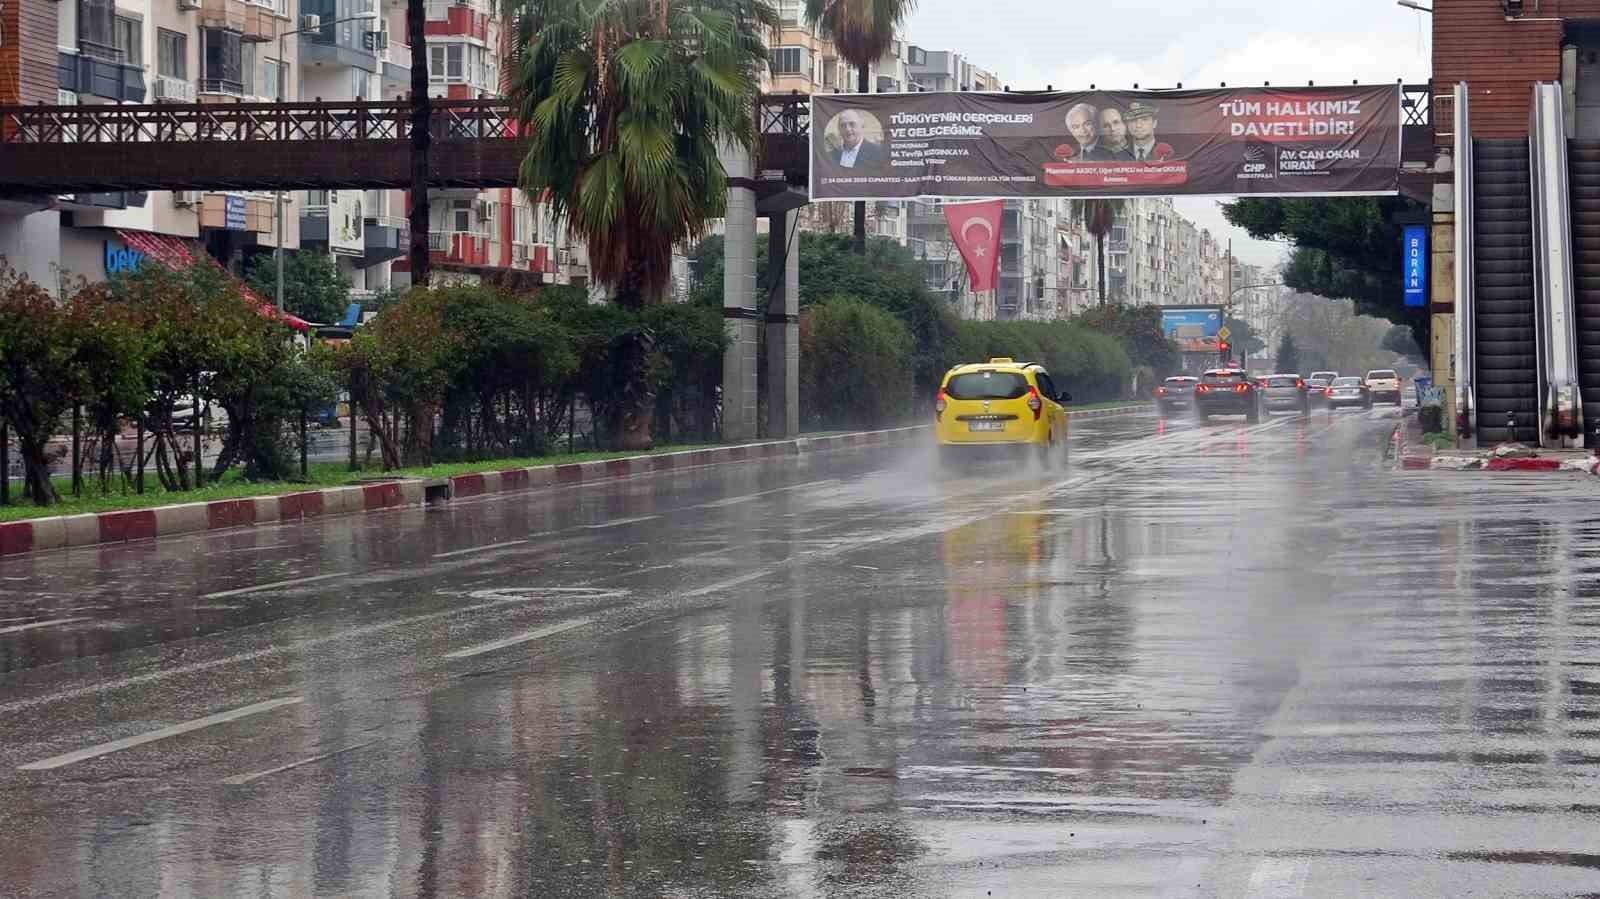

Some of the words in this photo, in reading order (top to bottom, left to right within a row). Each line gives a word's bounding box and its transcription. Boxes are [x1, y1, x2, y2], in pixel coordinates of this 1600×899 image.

[1219, 99, 1261, 116] TÜM
[1266, 100, 1361, 116] HALKIMIZ
[890, 112, 961, 124] TÜRKİYE'NİN
[963, 112, 1033, 124] GERÇEKLERİ
[890, 128, 906, 138] VE
[907, 124, 983, 137] GELECEĞİMİZ
[1231, 118, 1355, 136] DAVETLİDİR!
[1280, 150, 1297, 160] AV.
[1298, 150, 1324, 160] CAN
[1326, 149, 1360, 160] OKAN
[1243, 163, 1266, 173] CHP
[1280, 160, 1316, 170] KIRAN
[1411, 238, 1419, 288] BORAN
